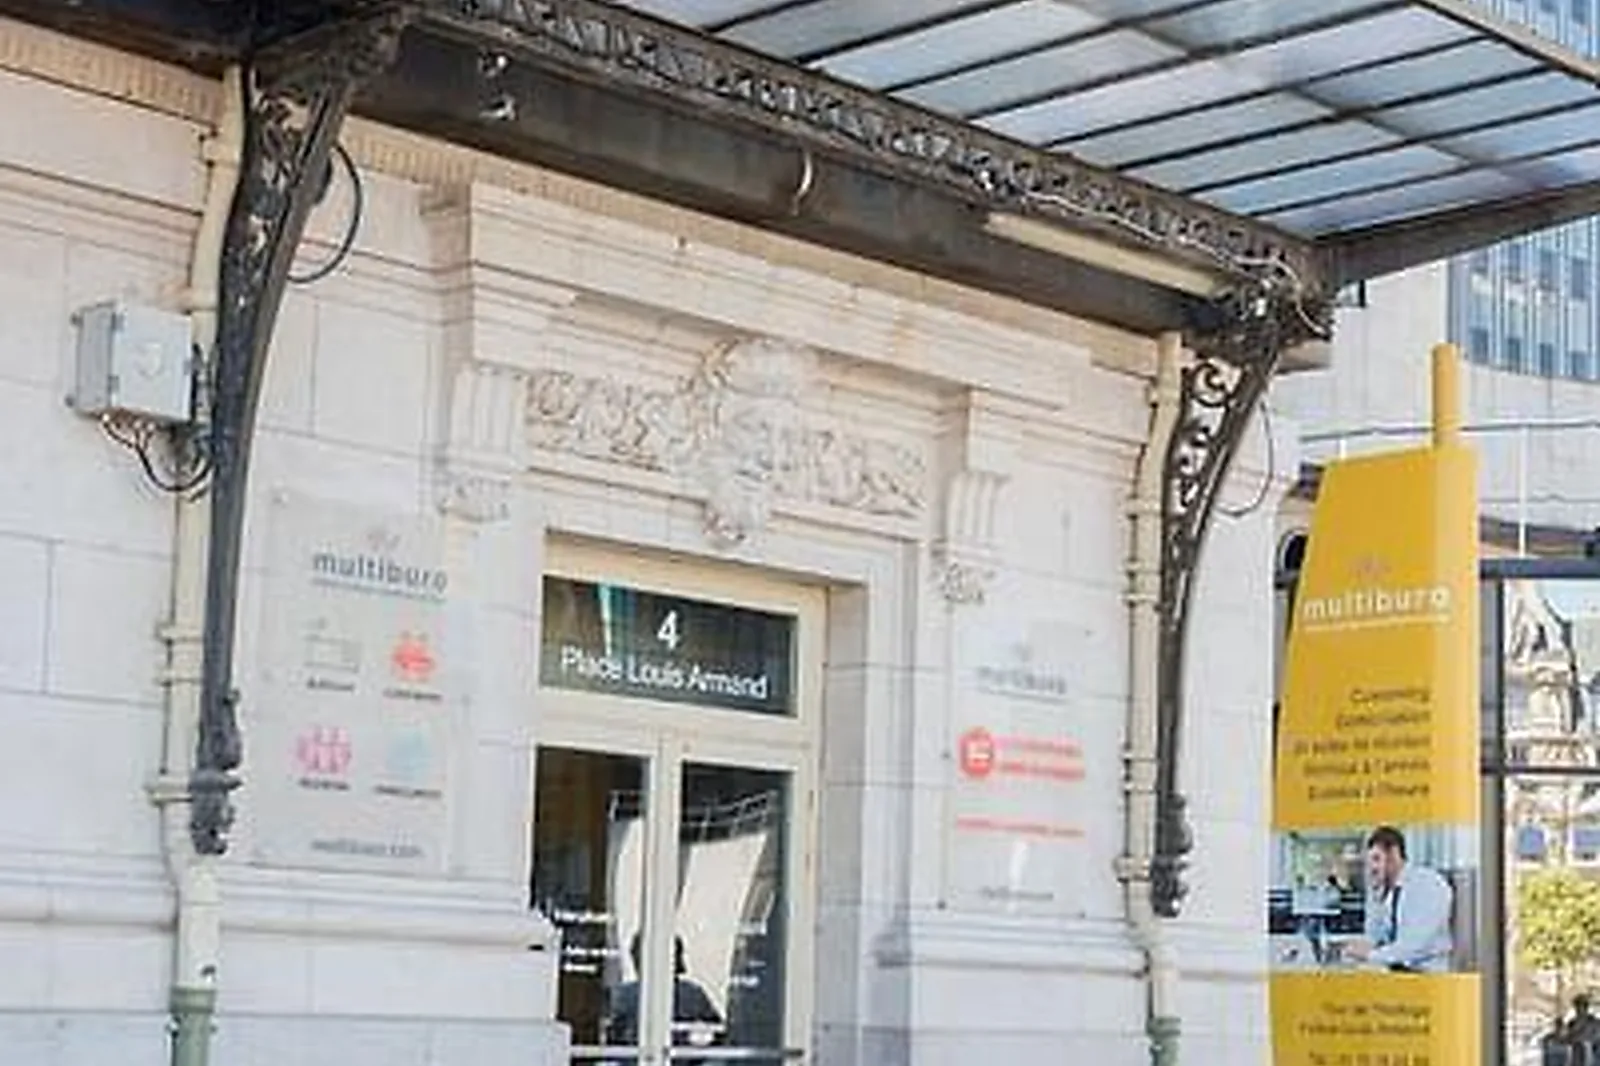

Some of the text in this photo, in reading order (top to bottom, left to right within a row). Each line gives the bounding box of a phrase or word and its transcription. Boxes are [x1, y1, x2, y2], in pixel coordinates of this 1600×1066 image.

[312, 551, 448, 593] multiburo
[1304, 586, 1450, 619] multiburo
[656, 610, 681, 649] 4
[562, 646, 768, 700] Place Louis Armand
